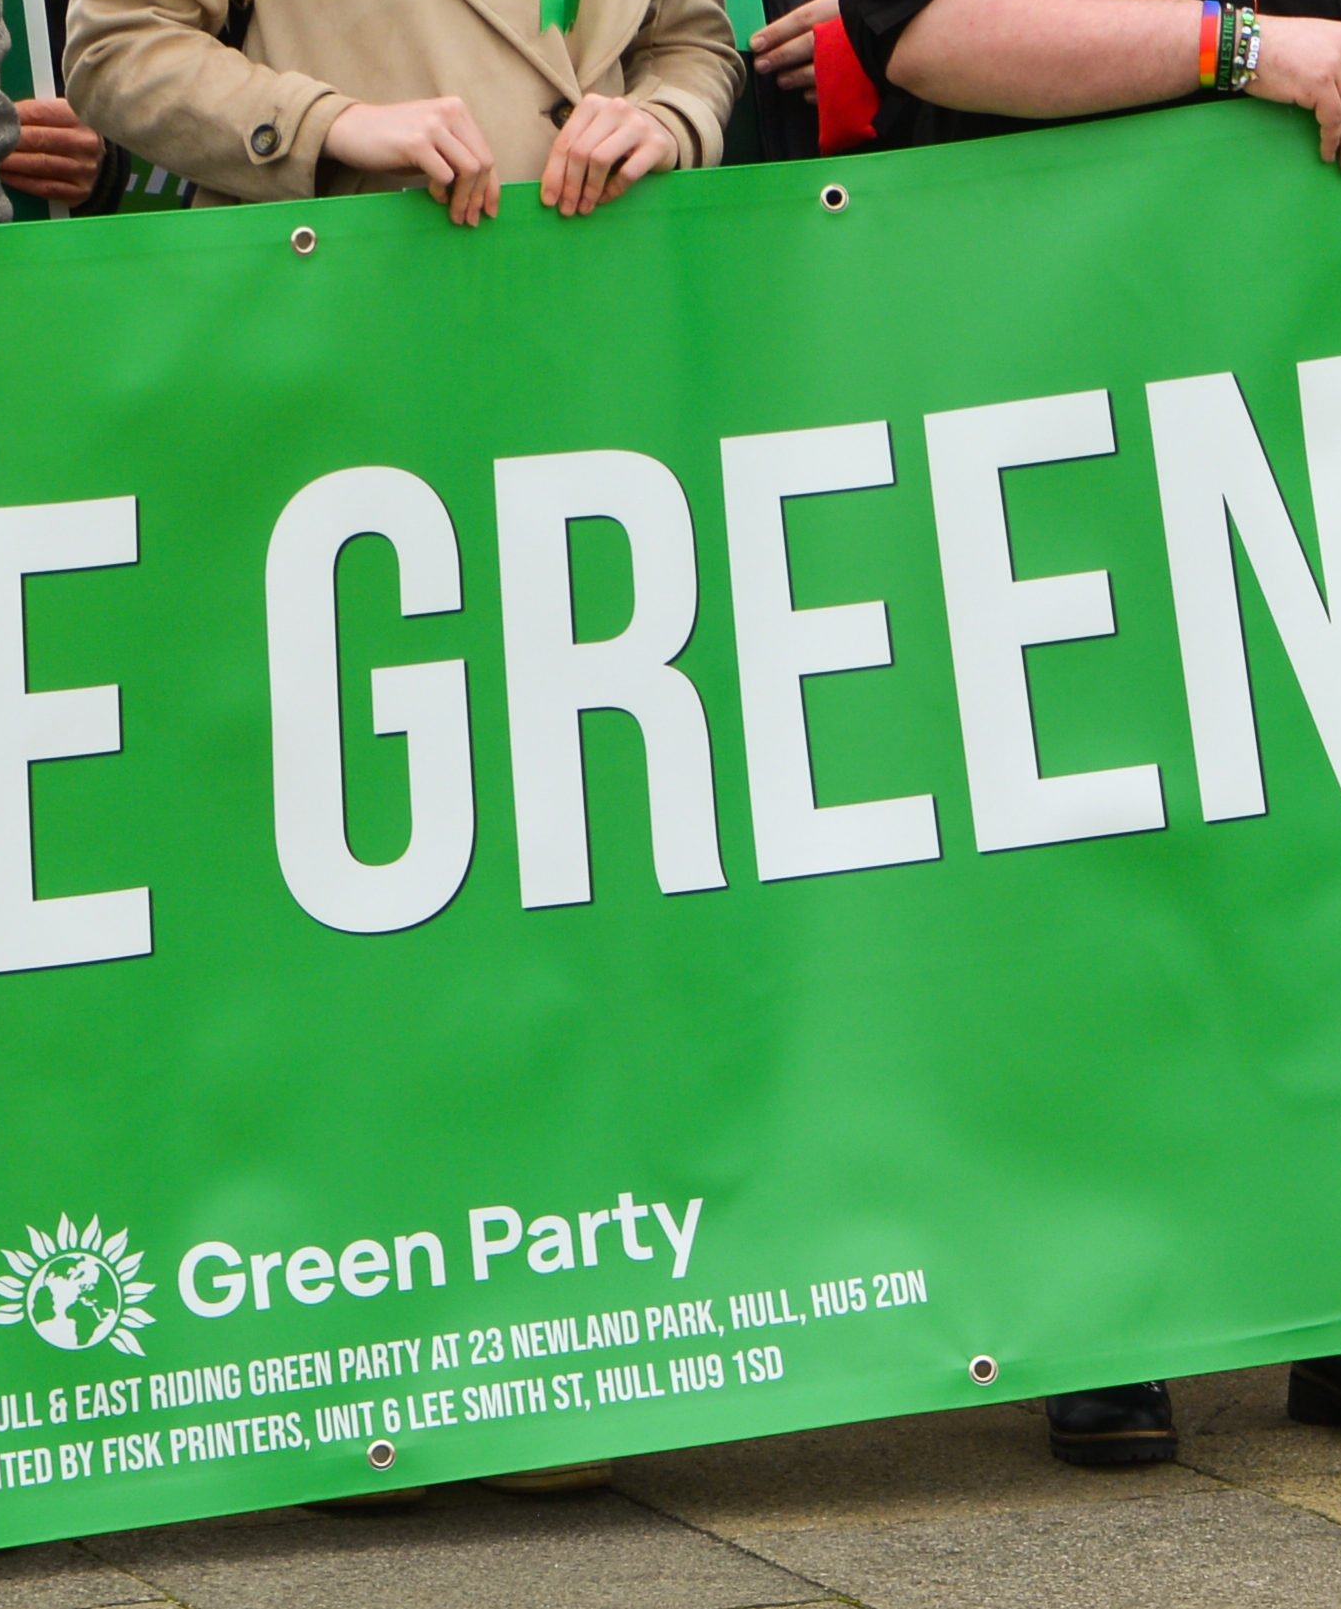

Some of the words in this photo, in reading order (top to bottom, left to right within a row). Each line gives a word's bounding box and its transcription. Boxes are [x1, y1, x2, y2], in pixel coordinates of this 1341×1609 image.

[179, 1231, 445, 1317] Green
[469, 1192, 702, 1280] Party
[49, 1389, 67, 1423] &
[76, 1378, 141, 1420] EAST
[150, 1364, 241, 1409] RIDING
[249, 1351, 332, 1395] GREEN
[339, 1338, 420, 1382] PARTY
[432, 1333, 460, 1370] AT
[468, 1328, 504, 1364] 23
[510, 1310, 639, 1359] NEWLAND
[645, 1299, 724, 1341] PARK,
[729, 1289, 806, 1329] HULL,
[811, 1278, 867, 1317] HU5
[874, 1269, 927, 1308] 2DN
[60, 1441, 93, 1479] BY
[103, 1432, 163, 1473] FISK
[170, 1412, 310, 1464] PRINTERS,
[316, 1401, 374, 1442] UNIT
[383, 1398, 401, 1433] 6
[407, 1390, 458, 1429] LEE
[462, 1378, 547, 1421] SMITH
[552, 1373, 591, 1411] ST,
[596, 1363, 665, 1403] HULL
[669, 1354, 724, 1393] HU9
[732, 1346, 783, 1384] 1SD
